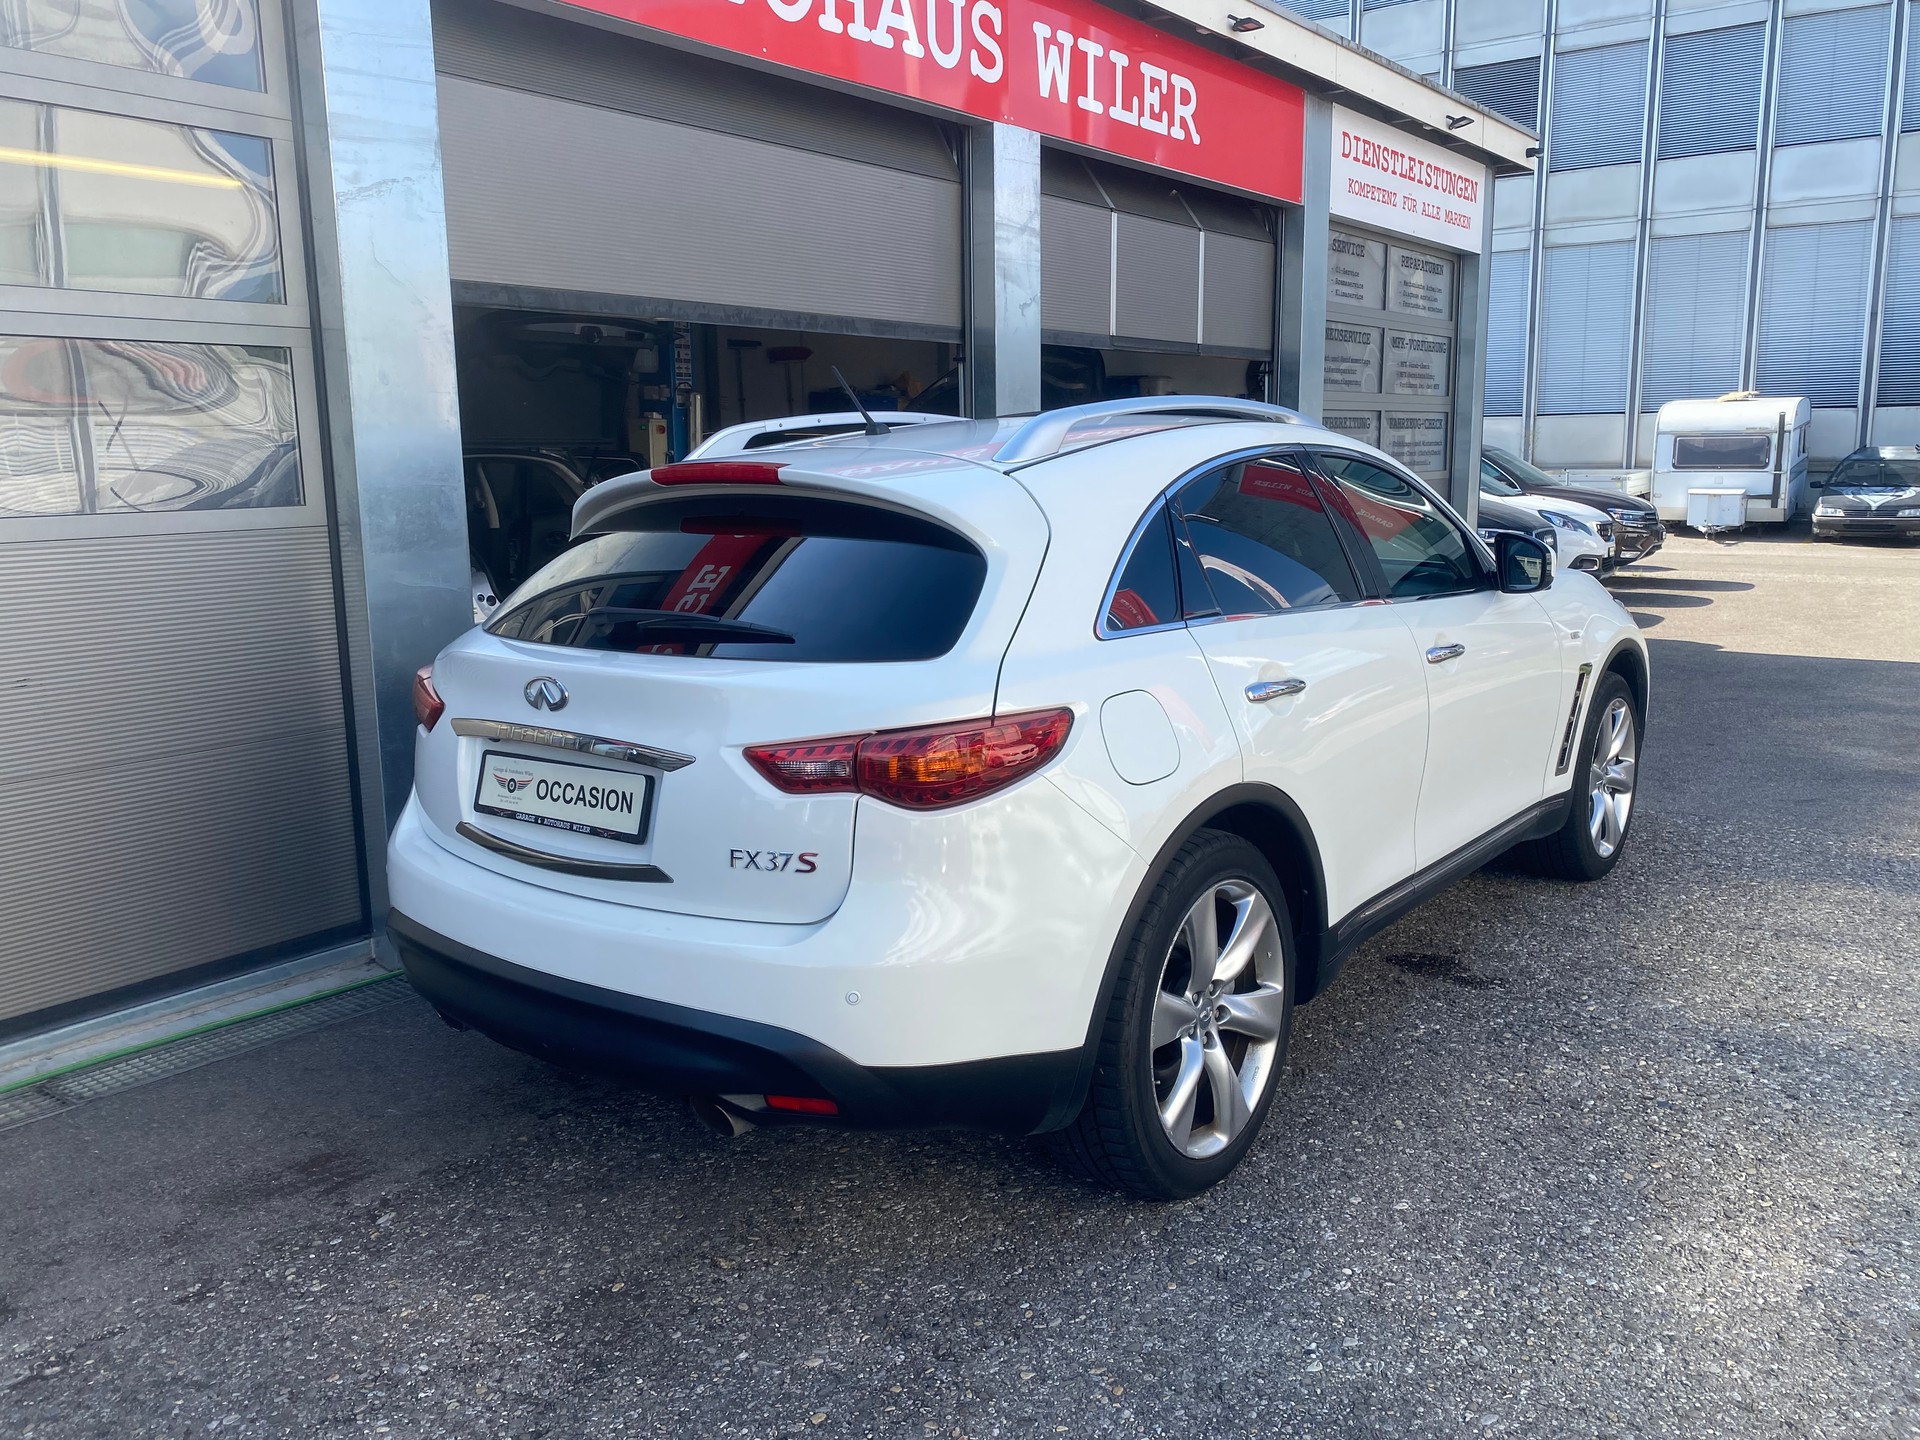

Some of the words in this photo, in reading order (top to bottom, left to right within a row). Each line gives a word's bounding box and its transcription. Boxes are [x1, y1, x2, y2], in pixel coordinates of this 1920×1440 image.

[1032, 21, 1201, 146] WILER
[1341, 131, 1479, 204] DIENSTLEISTUNGEN
[1348, 178, 1397, 208] KOMPETENZ
[1402, 193, 1418, 214] FÜR
[1422, 202, 1441, 221] ALLE
[1444, 209, 1472, 230] MARKEN
[1332, 238, 1366, 258] SERVICE
[1401, 255, 1445, 276] REPARATUREN
[1325, 327, 1372, 345] NEUSERVICE
[1389, 417, 1443, 430] FAHRZEUG-CHECK
[536, 779, 634, 814] OCCASION
[515, 813, 536, 823] GARAGE
[544, 818, 571, 830] AUTOHAUS
[572, 823, 591, 834] WILER
[730, 847, 819, 874] FX37S
